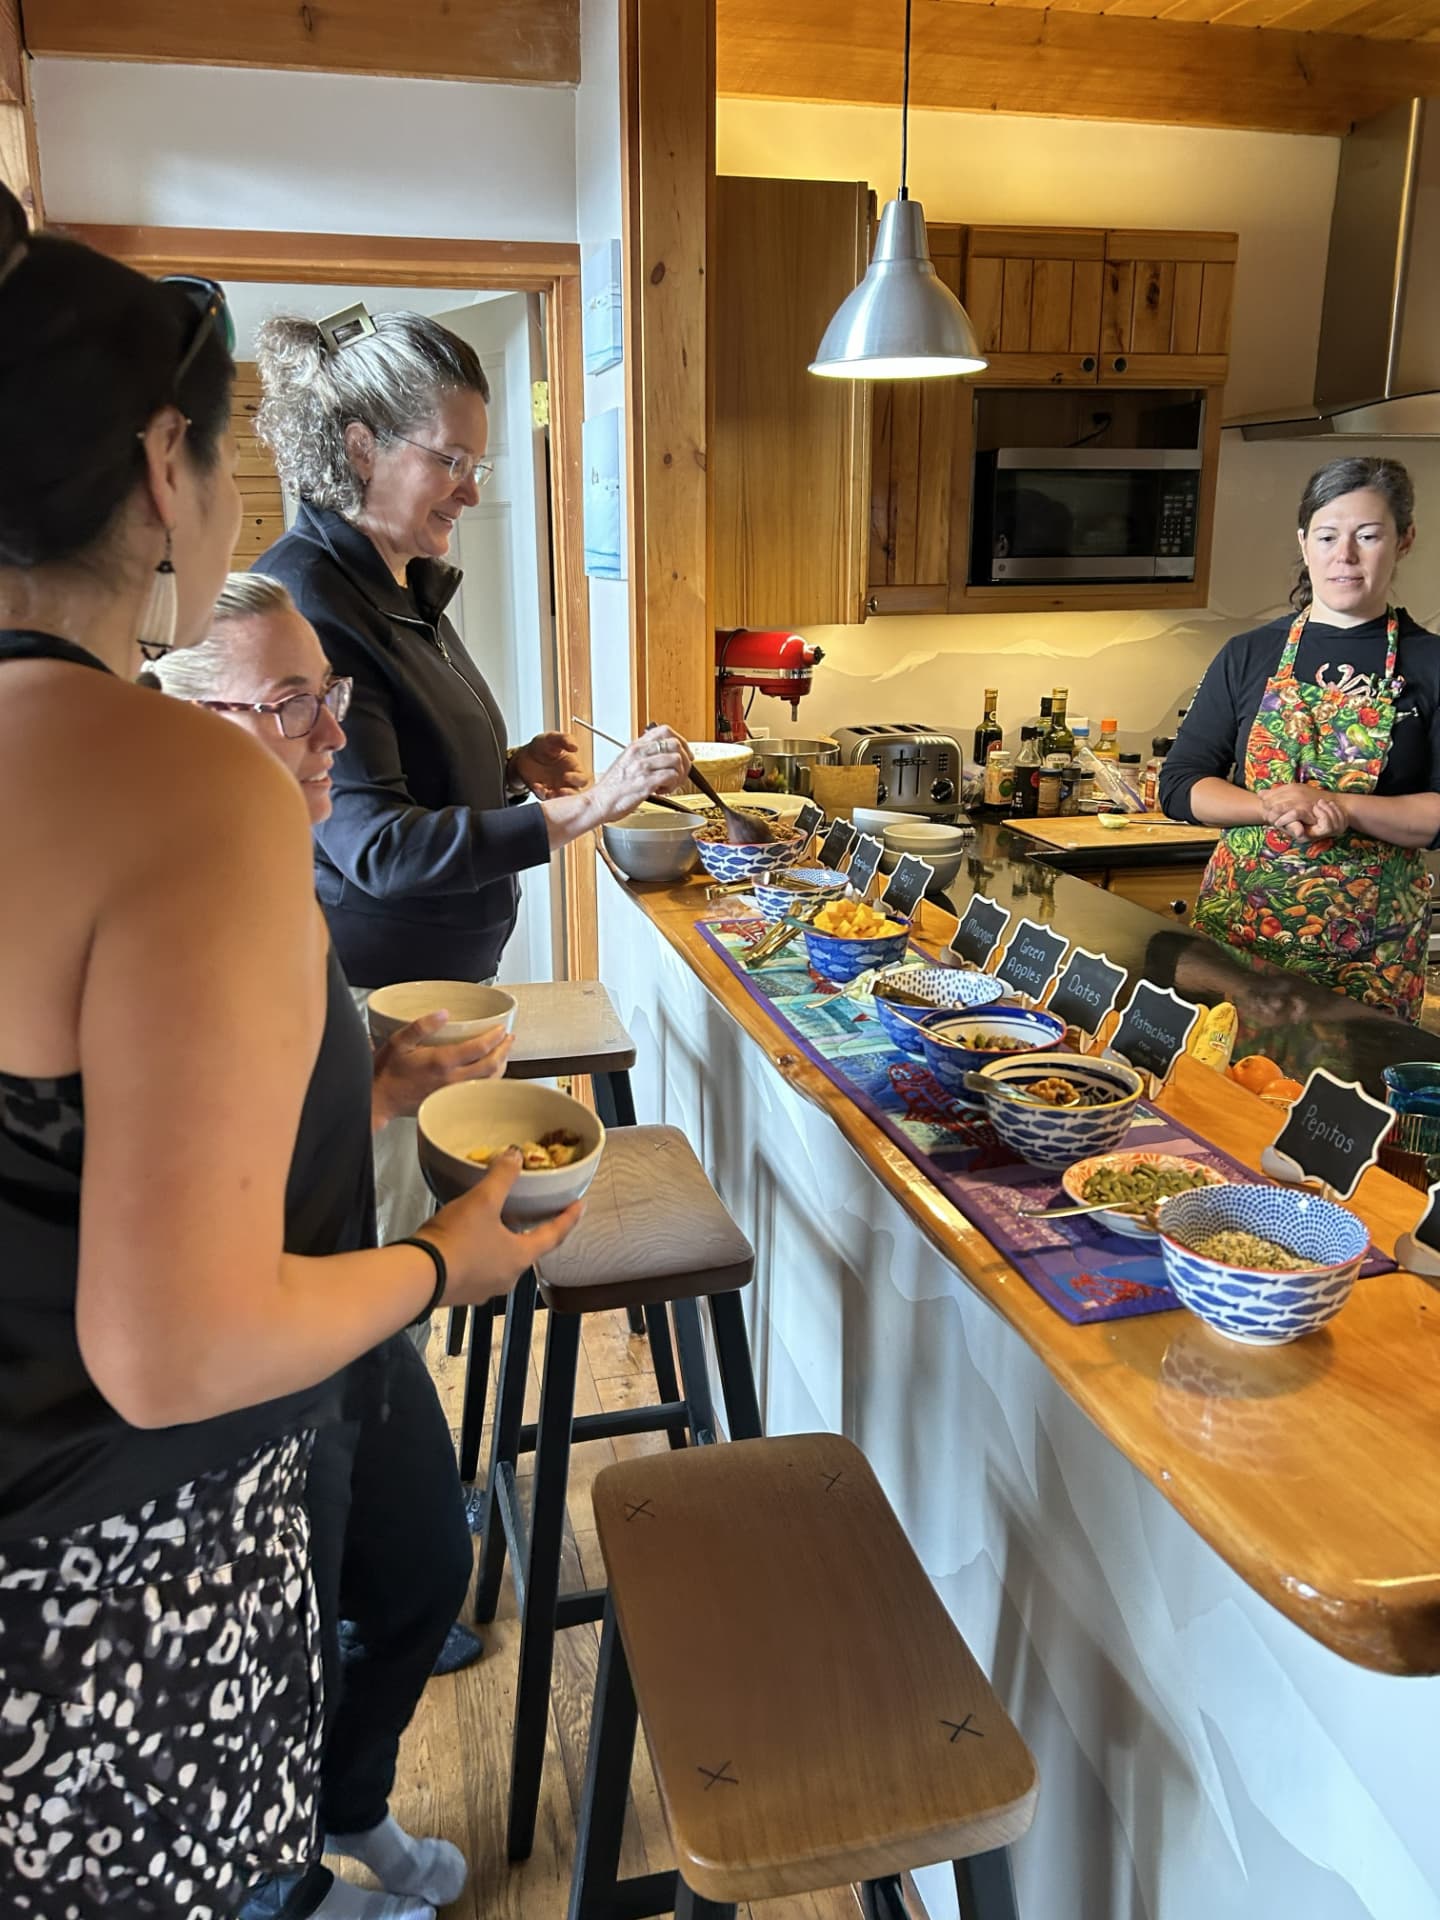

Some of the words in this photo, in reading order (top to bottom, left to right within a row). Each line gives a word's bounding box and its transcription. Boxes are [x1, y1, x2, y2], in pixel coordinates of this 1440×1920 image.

[1019, 937, 1046, 962] Green
[1006, 957, 1043, 985] Apples
[1067, 974, 1102, 1007] Dates
[1130, 1008, 1176, 1049] Pistachios
[1302, 1104, 1355, 1154] Pepitas
